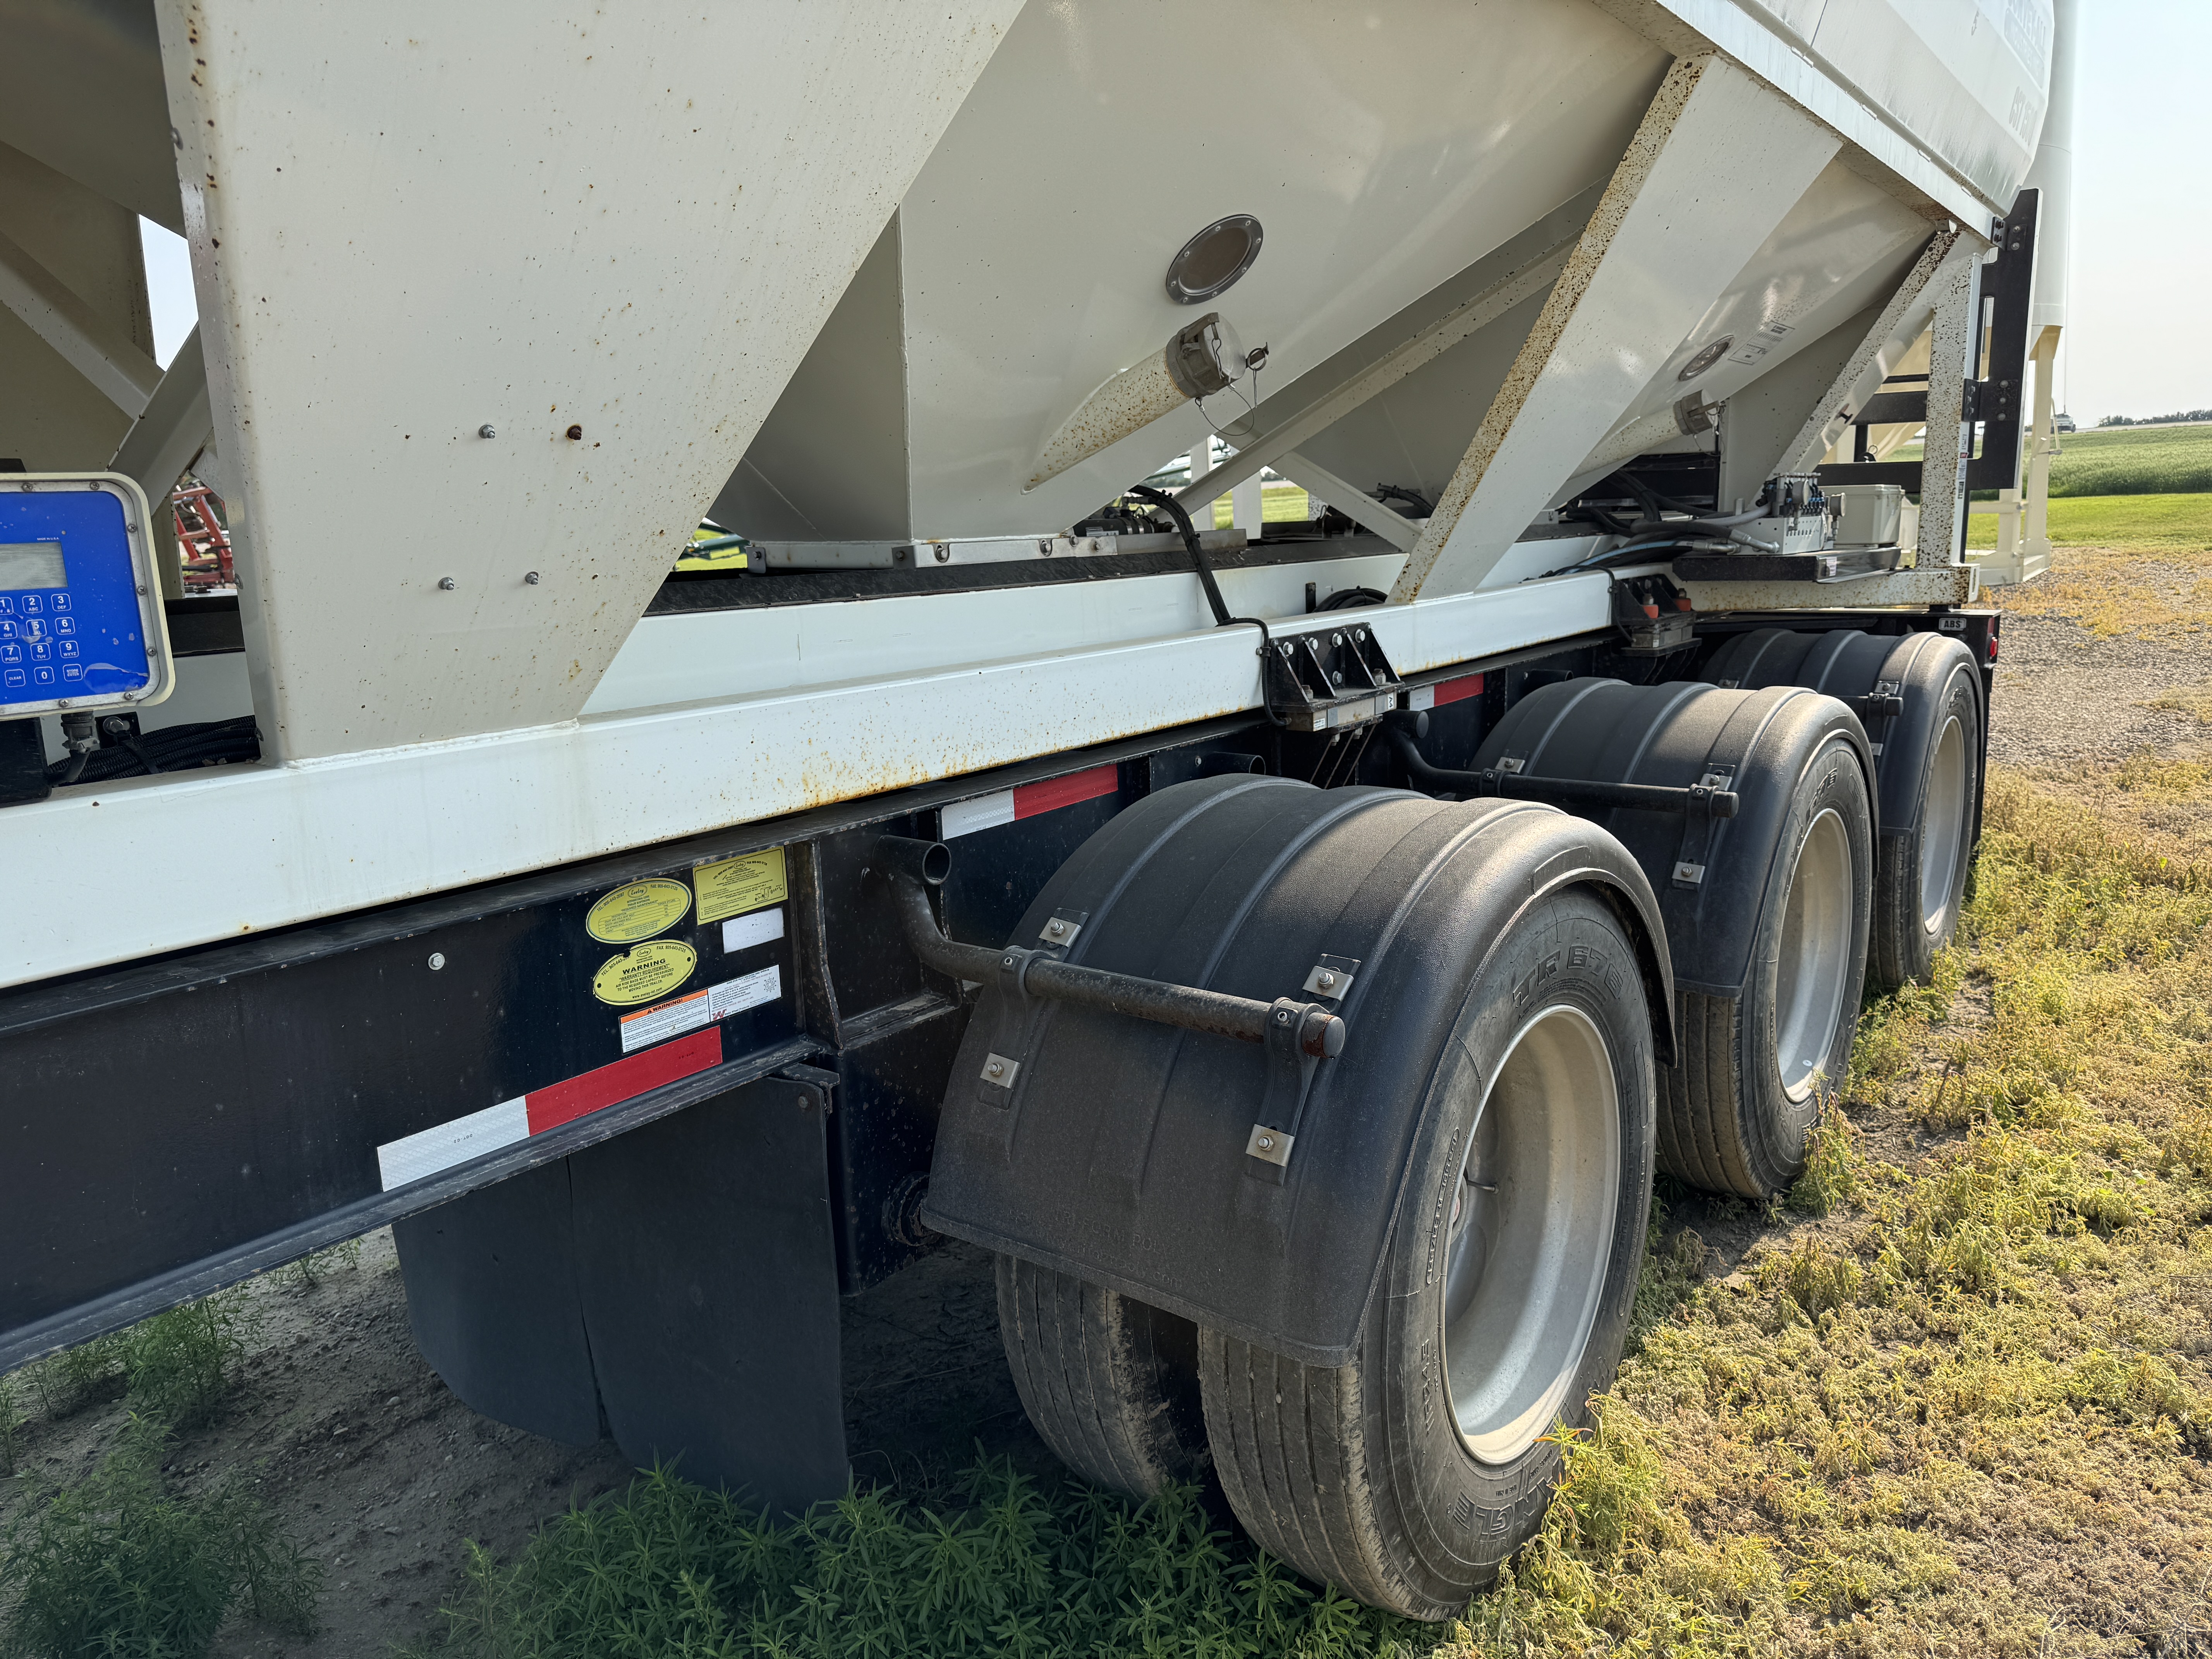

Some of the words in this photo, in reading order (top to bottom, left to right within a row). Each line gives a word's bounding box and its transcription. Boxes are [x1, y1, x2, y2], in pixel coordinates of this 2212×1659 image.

[33, 621, 39, 629] 5
[622, 958, 666, 975] WARNING
[1513, 950, 1560, 1006] TR
[653, 998, 683, 1012] WARNING!
[453, 1133, 473, 1144] DOT-C2
